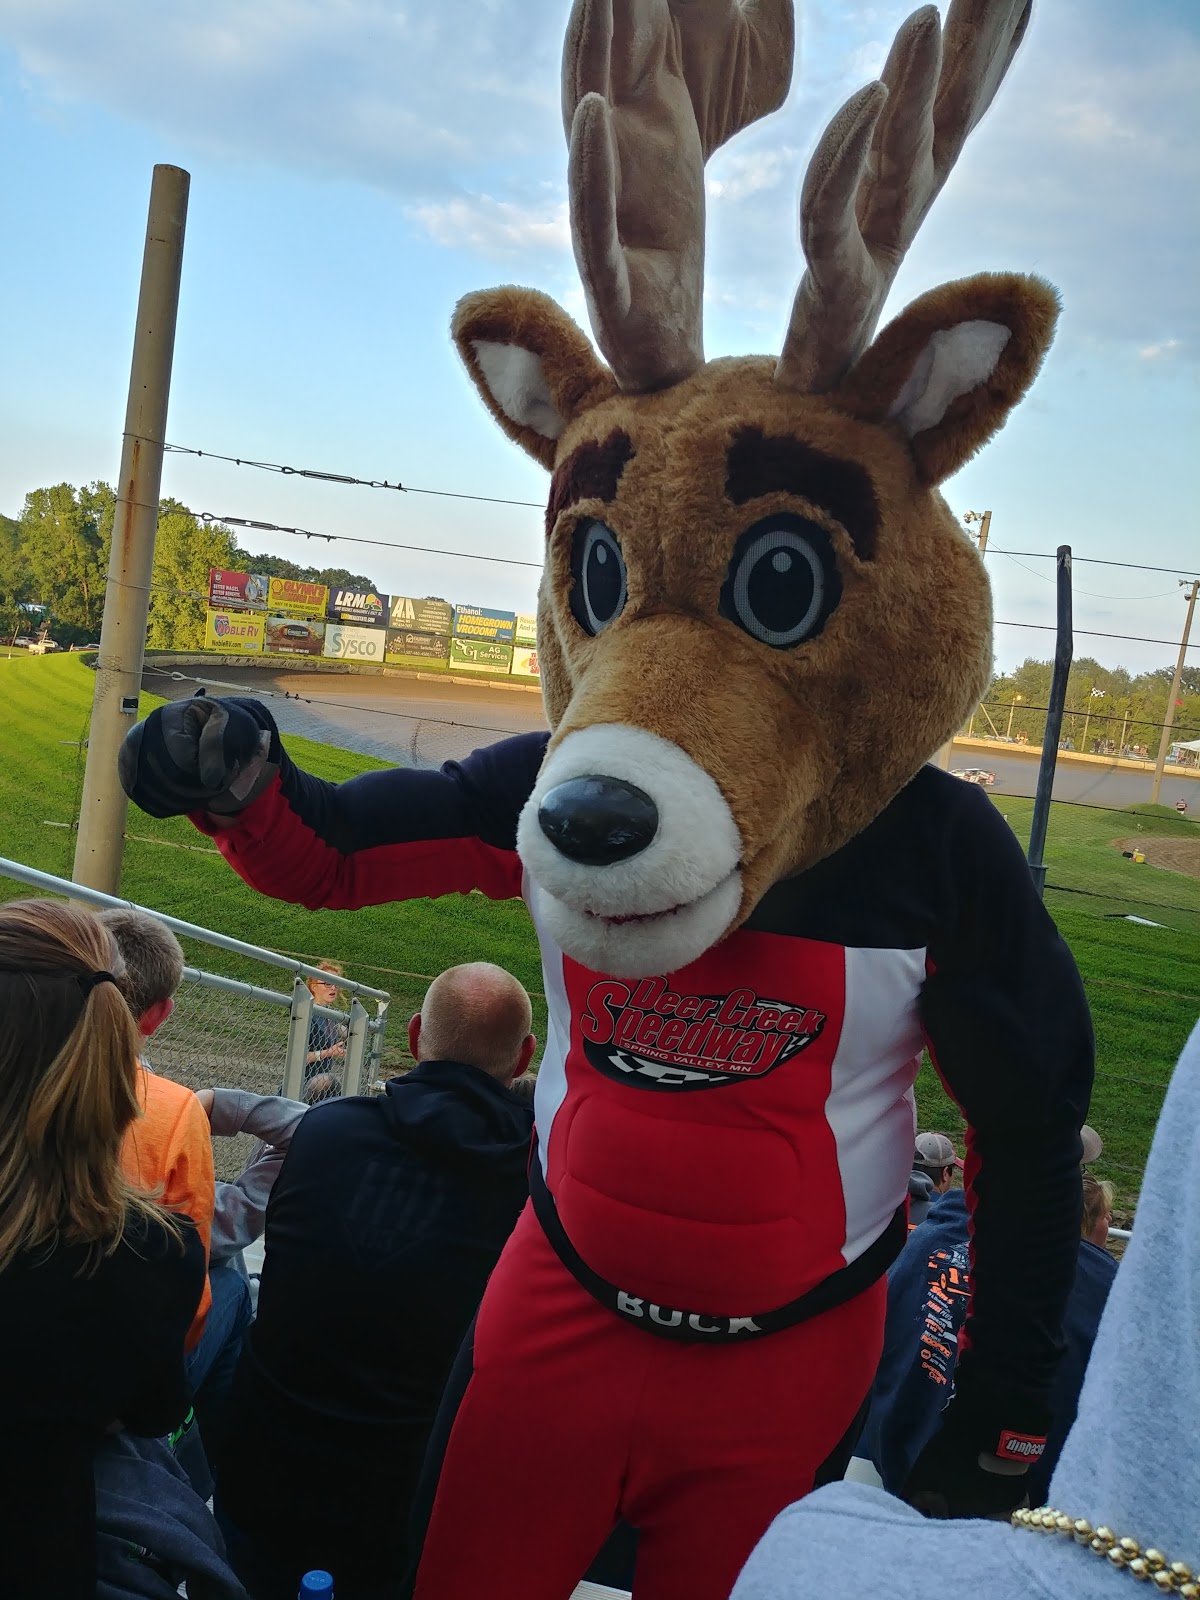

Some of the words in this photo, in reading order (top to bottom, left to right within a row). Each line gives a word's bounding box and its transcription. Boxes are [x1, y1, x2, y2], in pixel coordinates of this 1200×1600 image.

[284, 580, 326, 598] GLYNN'S
[334, 591, 366, 608] LRM
[456, 606, 483, 616] Ethanol:
[217, 623, 246, 636] NOBLE
[456, 624, 498, 637] VROOOM!!
[458, 615, 513, 629] HOMEGROWN
[212, 640, 242, 648] NobleRV.com
[456, 640, 477, 660] SGI
[480, 652, 508, 660] Services
[631, 976, 720, 1021] Deer
[716, 988, 826, 1036] Creek
[580, 980, 792, 1069] Speedway
[623, 1042, 668, 1060] SPRING
[672, 1052, 724, 1070] VALLEY,
[729, 1064, 752, 1073] MN
[617, 1290, 762, 1334] BUCK
[940, 1310, 954, 1320] PLUS
[920, 1334, 952, 1358] ROOFING
